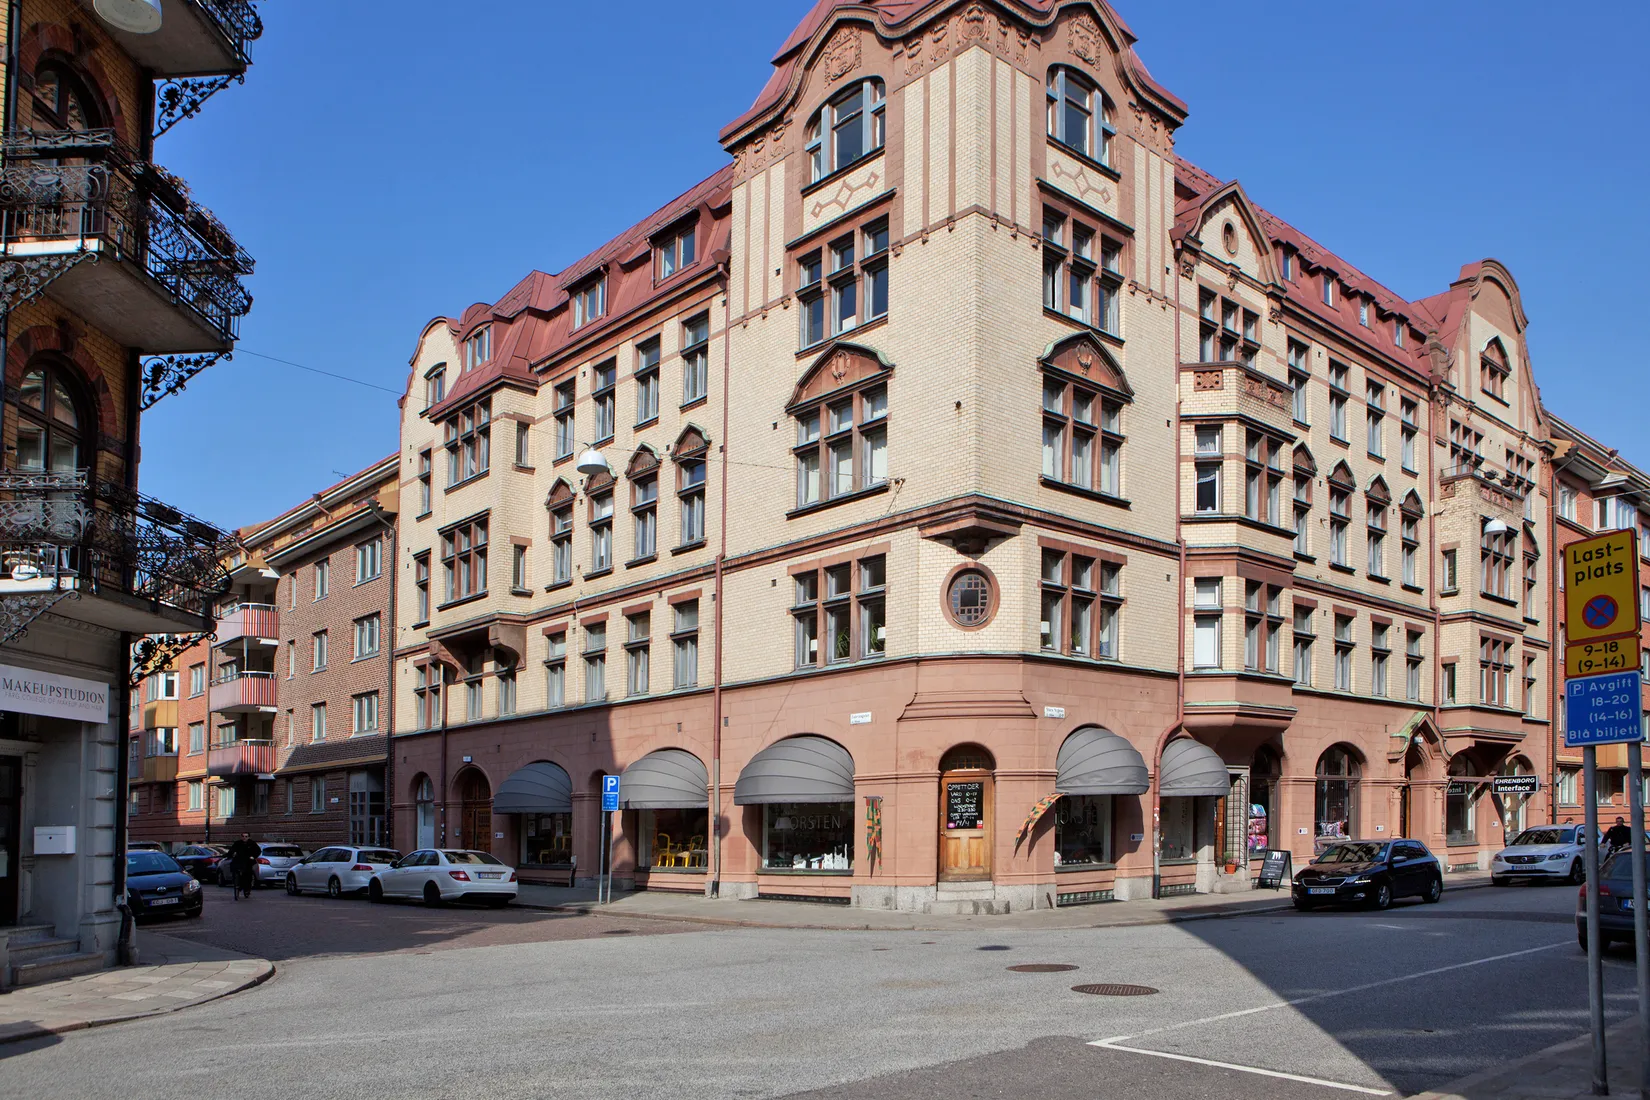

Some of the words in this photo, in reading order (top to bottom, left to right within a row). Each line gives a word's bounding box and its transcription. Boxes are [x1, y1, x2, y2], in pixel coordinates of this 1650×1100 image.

[1573, 542, 1624, 564] Last-
[1575, 561, 1624, 586] plats
[1584, 641, 1619, 656] 9-18
[1578, 654, 1625, 673] (9-14)
[2, 677, 105, 704] MAKEUPSTUDION
[1589, 678, 1632, 692] Avgift
[1592, 694, 1630, 707] 18-20
[1589, 708, 1633, 723] (14-16)
[1569, 728, 1590, 740] Blå
[1596, 725, 1638, 738] biljett
[607, 778, 616, 791] P
[790, 816, 840, 830] ORSTEN
